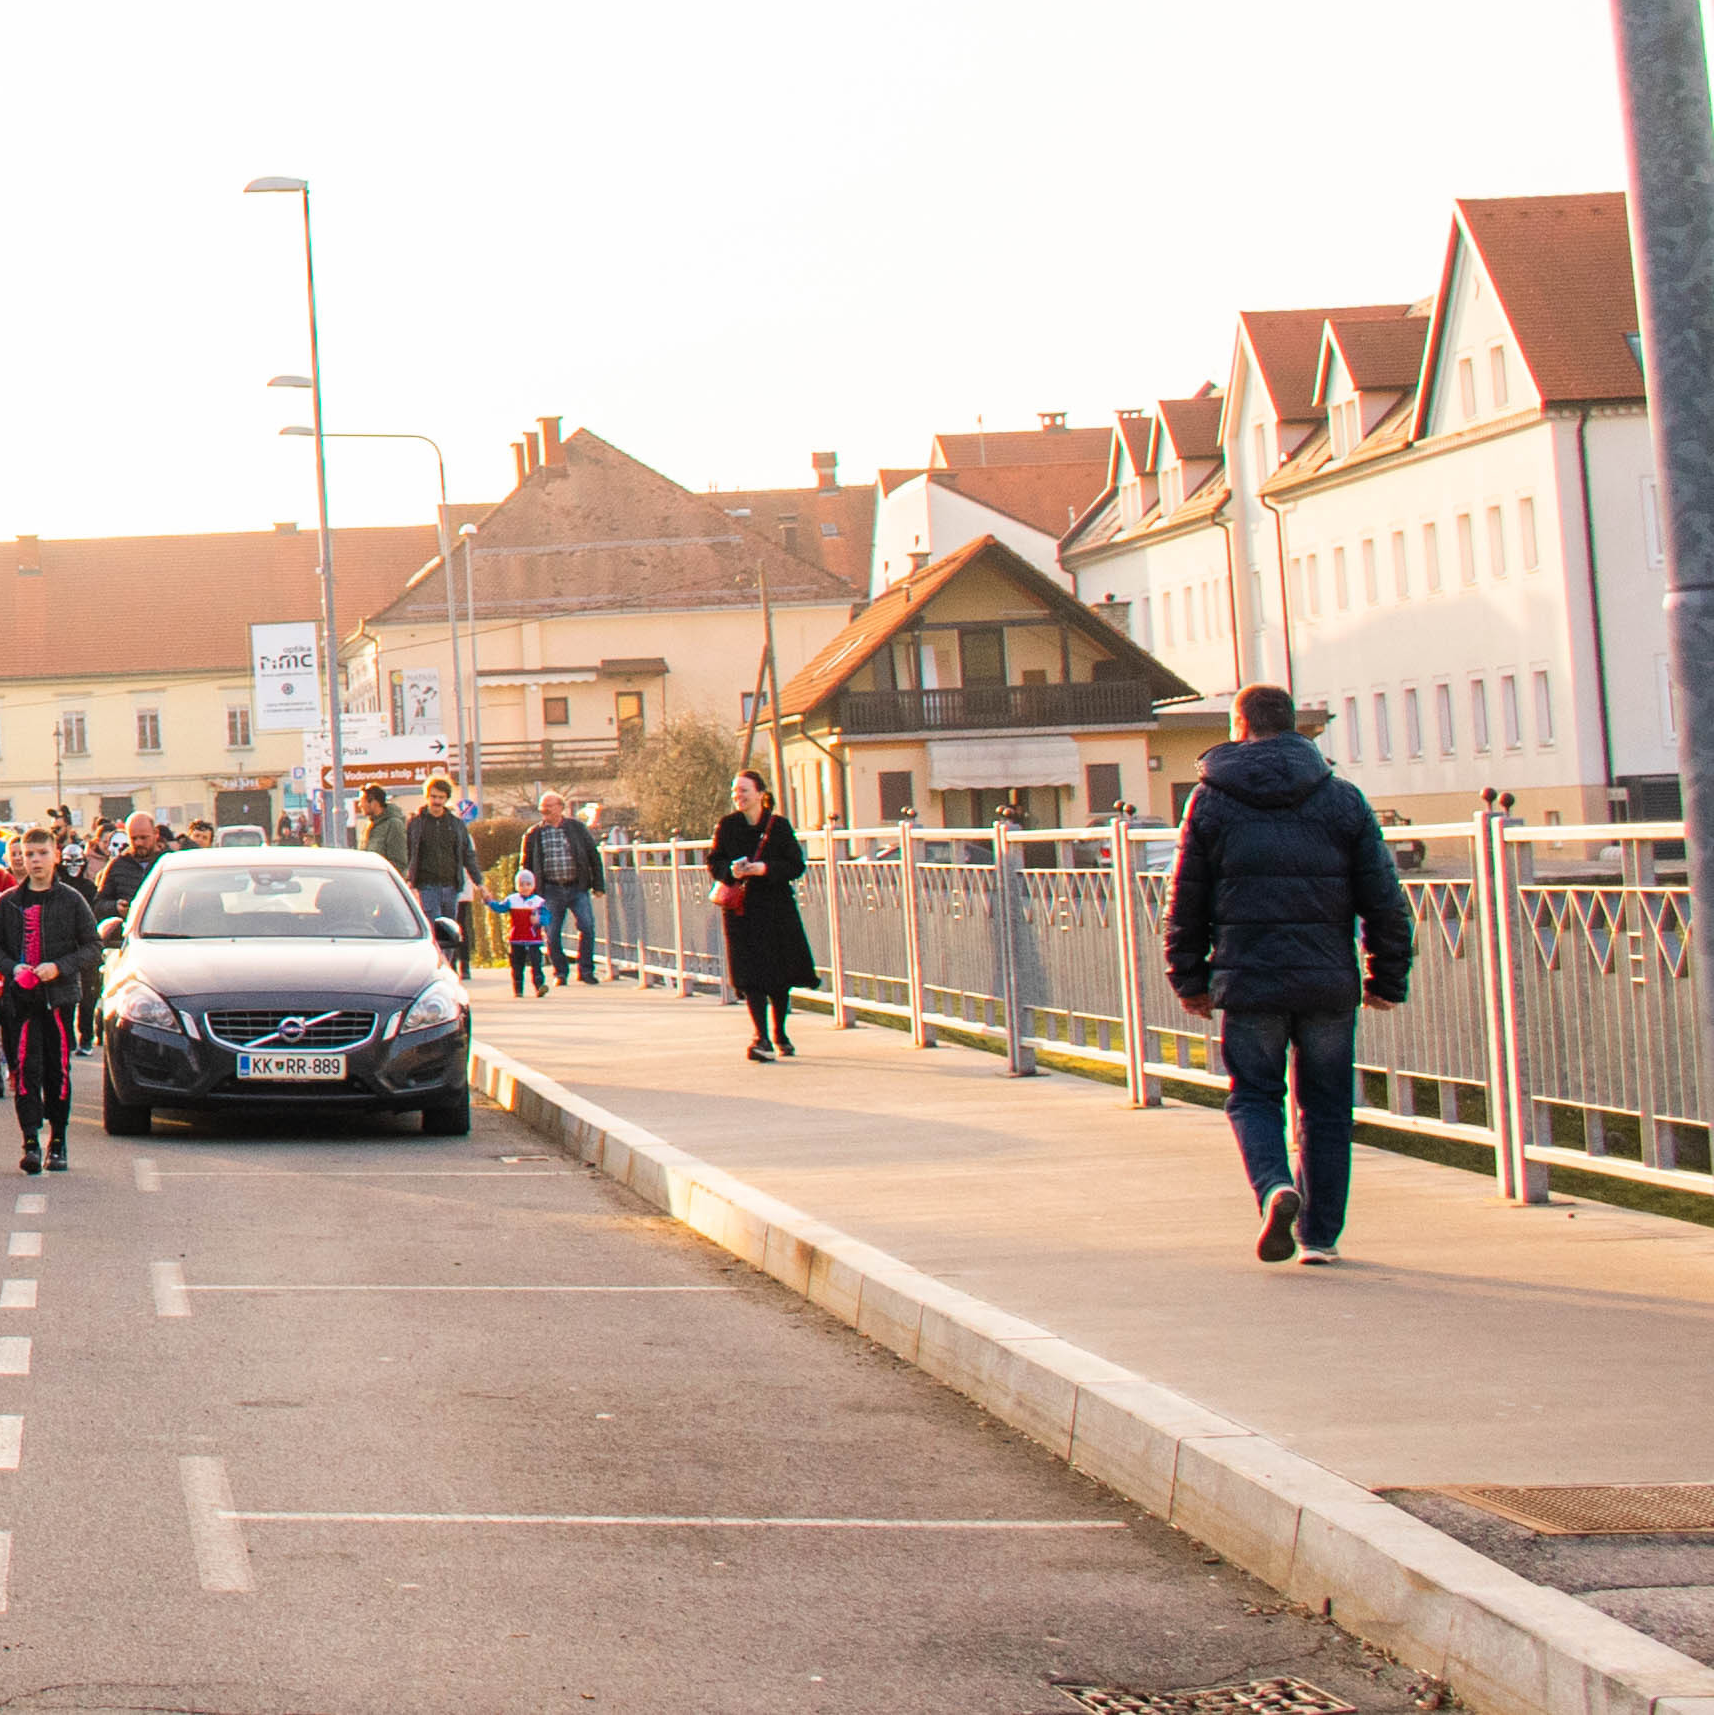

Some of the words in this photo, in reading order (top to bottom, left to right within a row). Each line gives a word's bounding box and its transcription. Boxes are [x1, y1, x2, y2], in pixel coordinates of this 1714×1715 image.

[282, 645, 312, 653] optika
[342, 746, 368, 756] Pošta
[343, 769, 389, 782] Vodovodni
[390, 768, 412, 781] stolp
[252, 1058, 273, 1074] KK
[286, 1058, 341, 1075] RR-889
